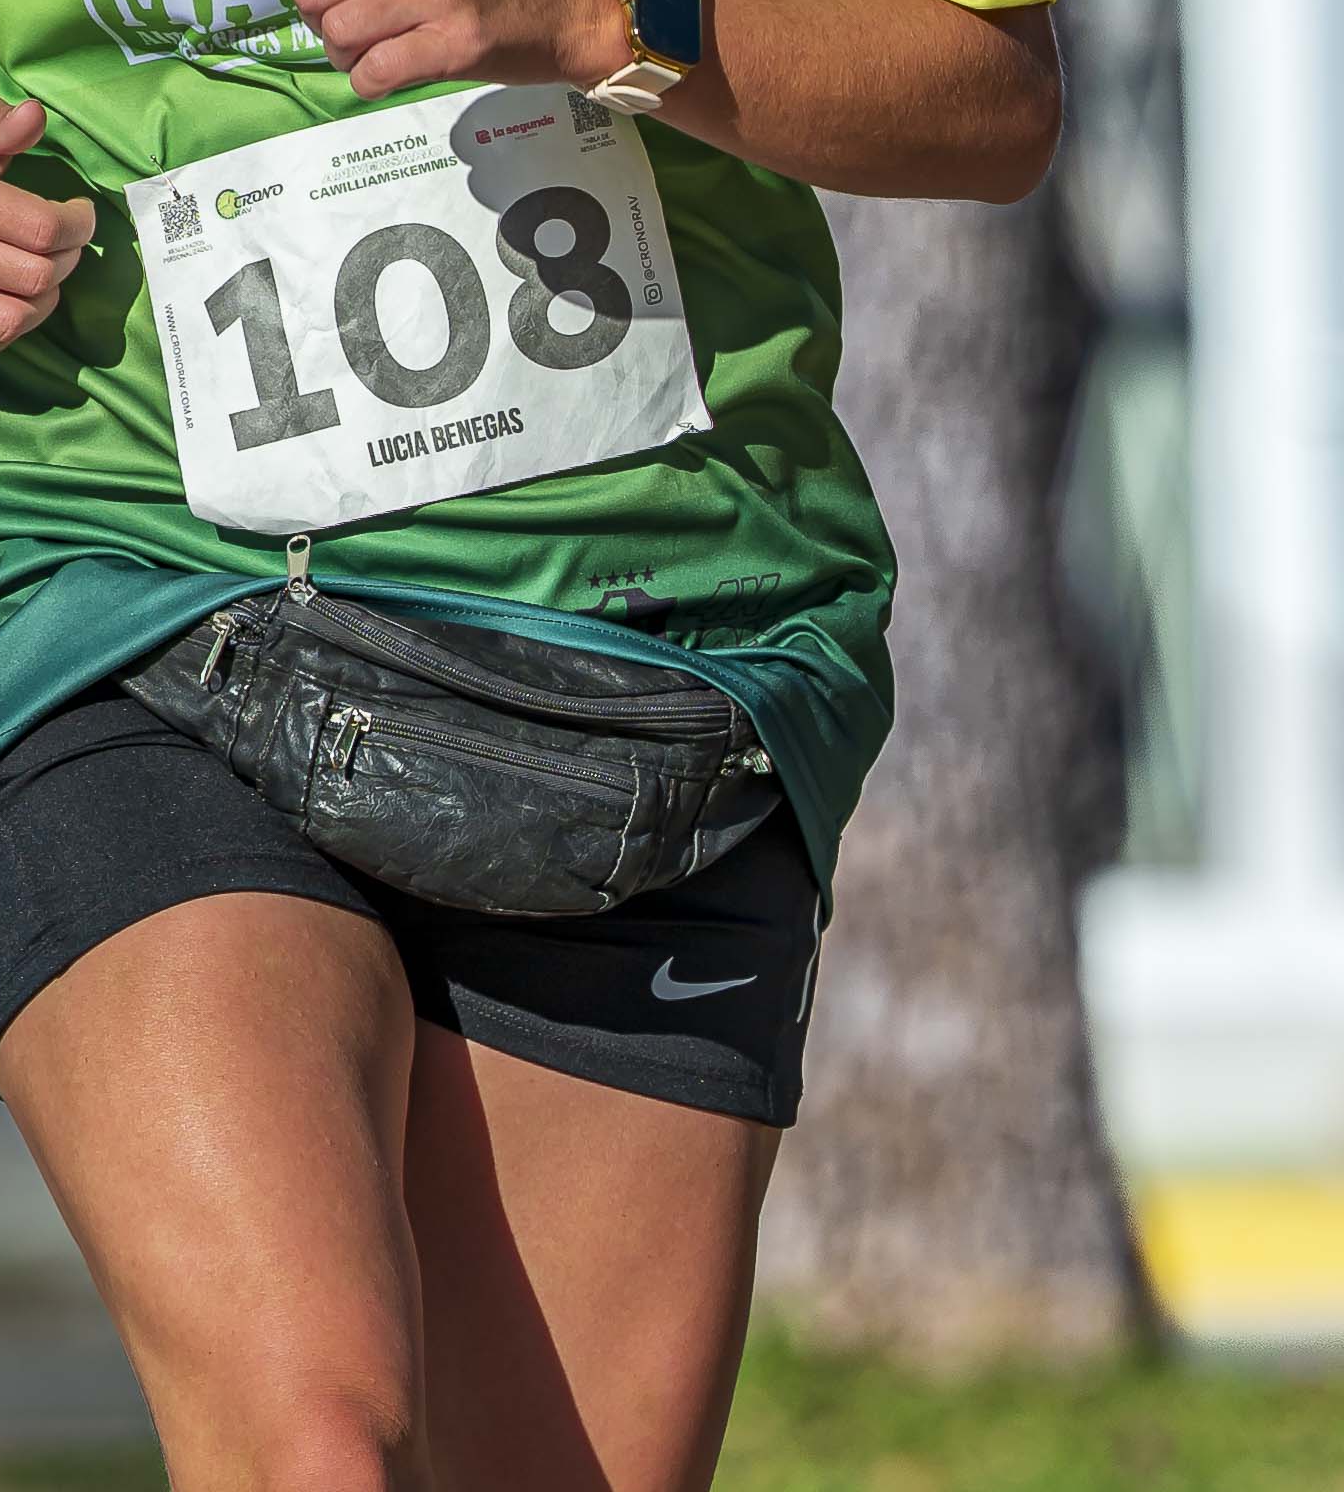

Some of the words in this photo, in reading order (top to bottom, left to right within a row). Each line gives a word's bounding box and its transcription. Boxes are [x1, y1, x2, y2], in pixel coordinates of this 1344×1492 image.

[492, 127, 505, 138] la
[506, 115, 555, 135] segunda
[309, 155, 460, 200] CAWILLIAMSKEMMIS
[627, 195, 656, 281] @CRONORAV
[203, 185, 633, 452] 108
[366, 430, 430, 468] LUCIA
[430, 407, 524, 453] BENEGAS
